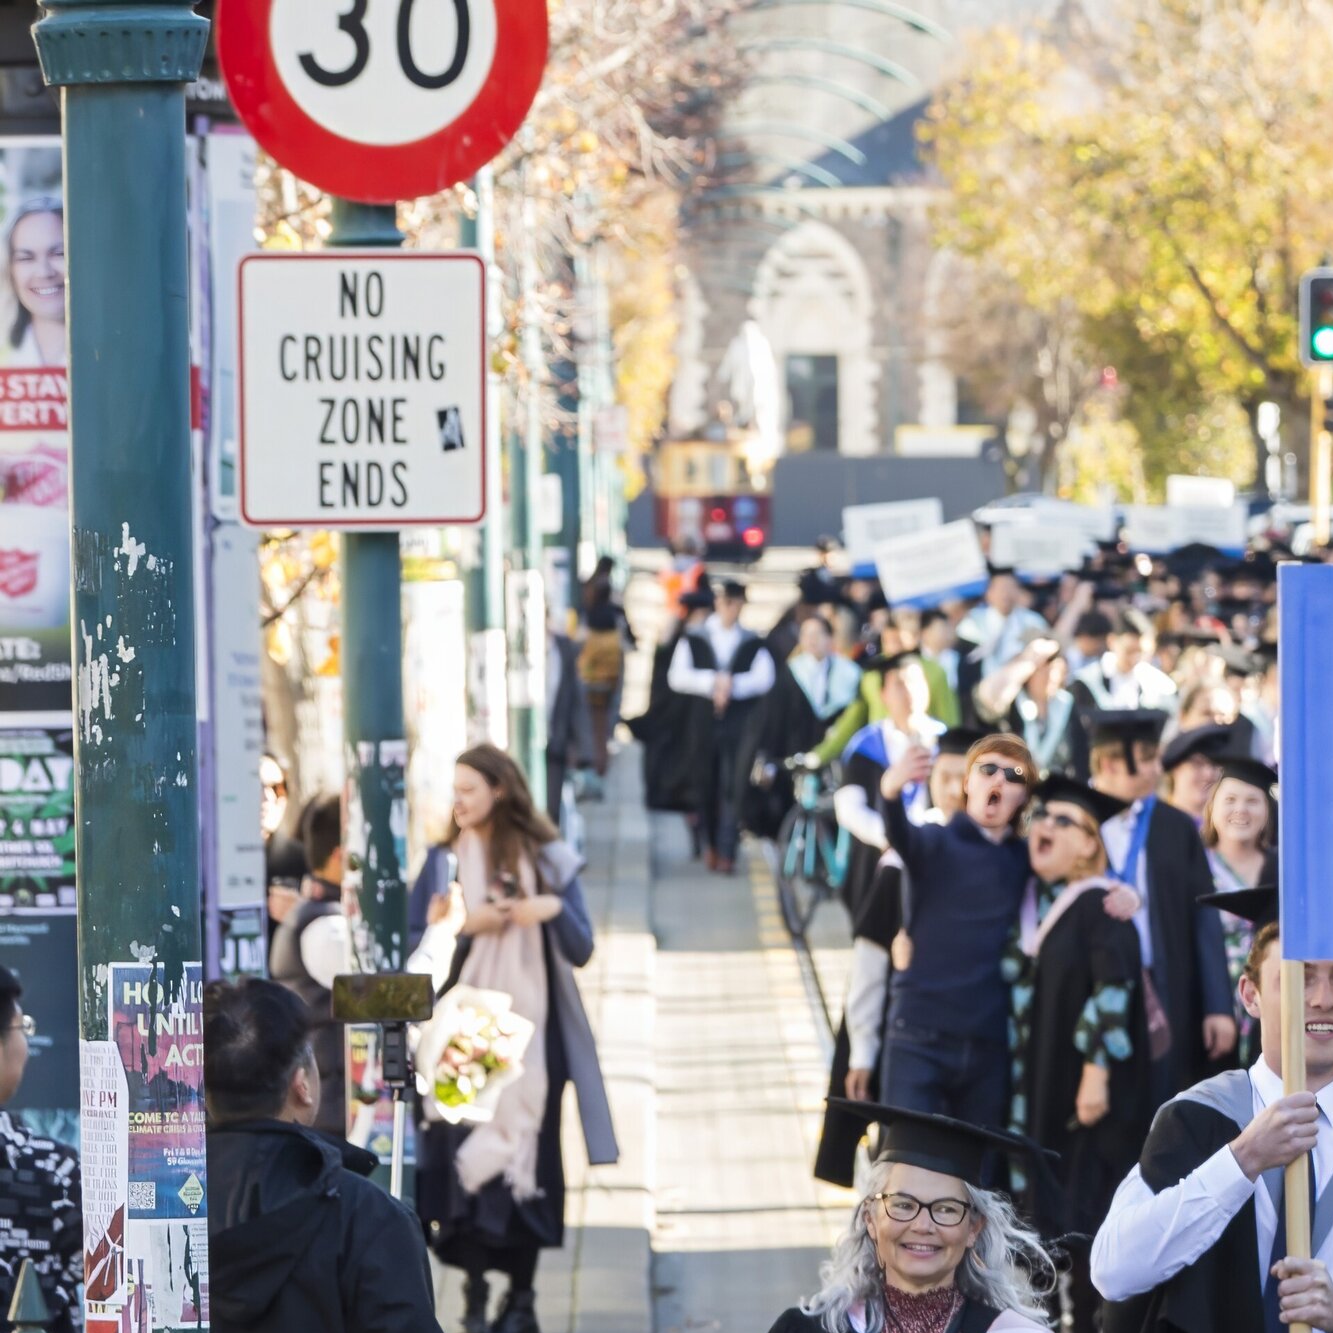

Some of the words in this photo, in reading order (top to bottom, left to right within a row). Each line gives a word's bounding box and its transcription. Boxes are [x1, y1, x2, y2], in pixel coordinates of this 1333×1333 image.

[298, 0, 470, 90] 30
[339, 271, 384, 318] NO
[279, 335, 445, 382] CRUISING
[318, 398, 408, 446] ZONE
[319, 461, 409, 508] ENDS
[137, 1012, 199, 1036] UNTIL
[99, 1091, 117, 1108] PM
[128, 1112, 161, 1123] COME
[182, 1112, 189, 1122] A
[128, 1125, 160, 1134] CLIMATE
